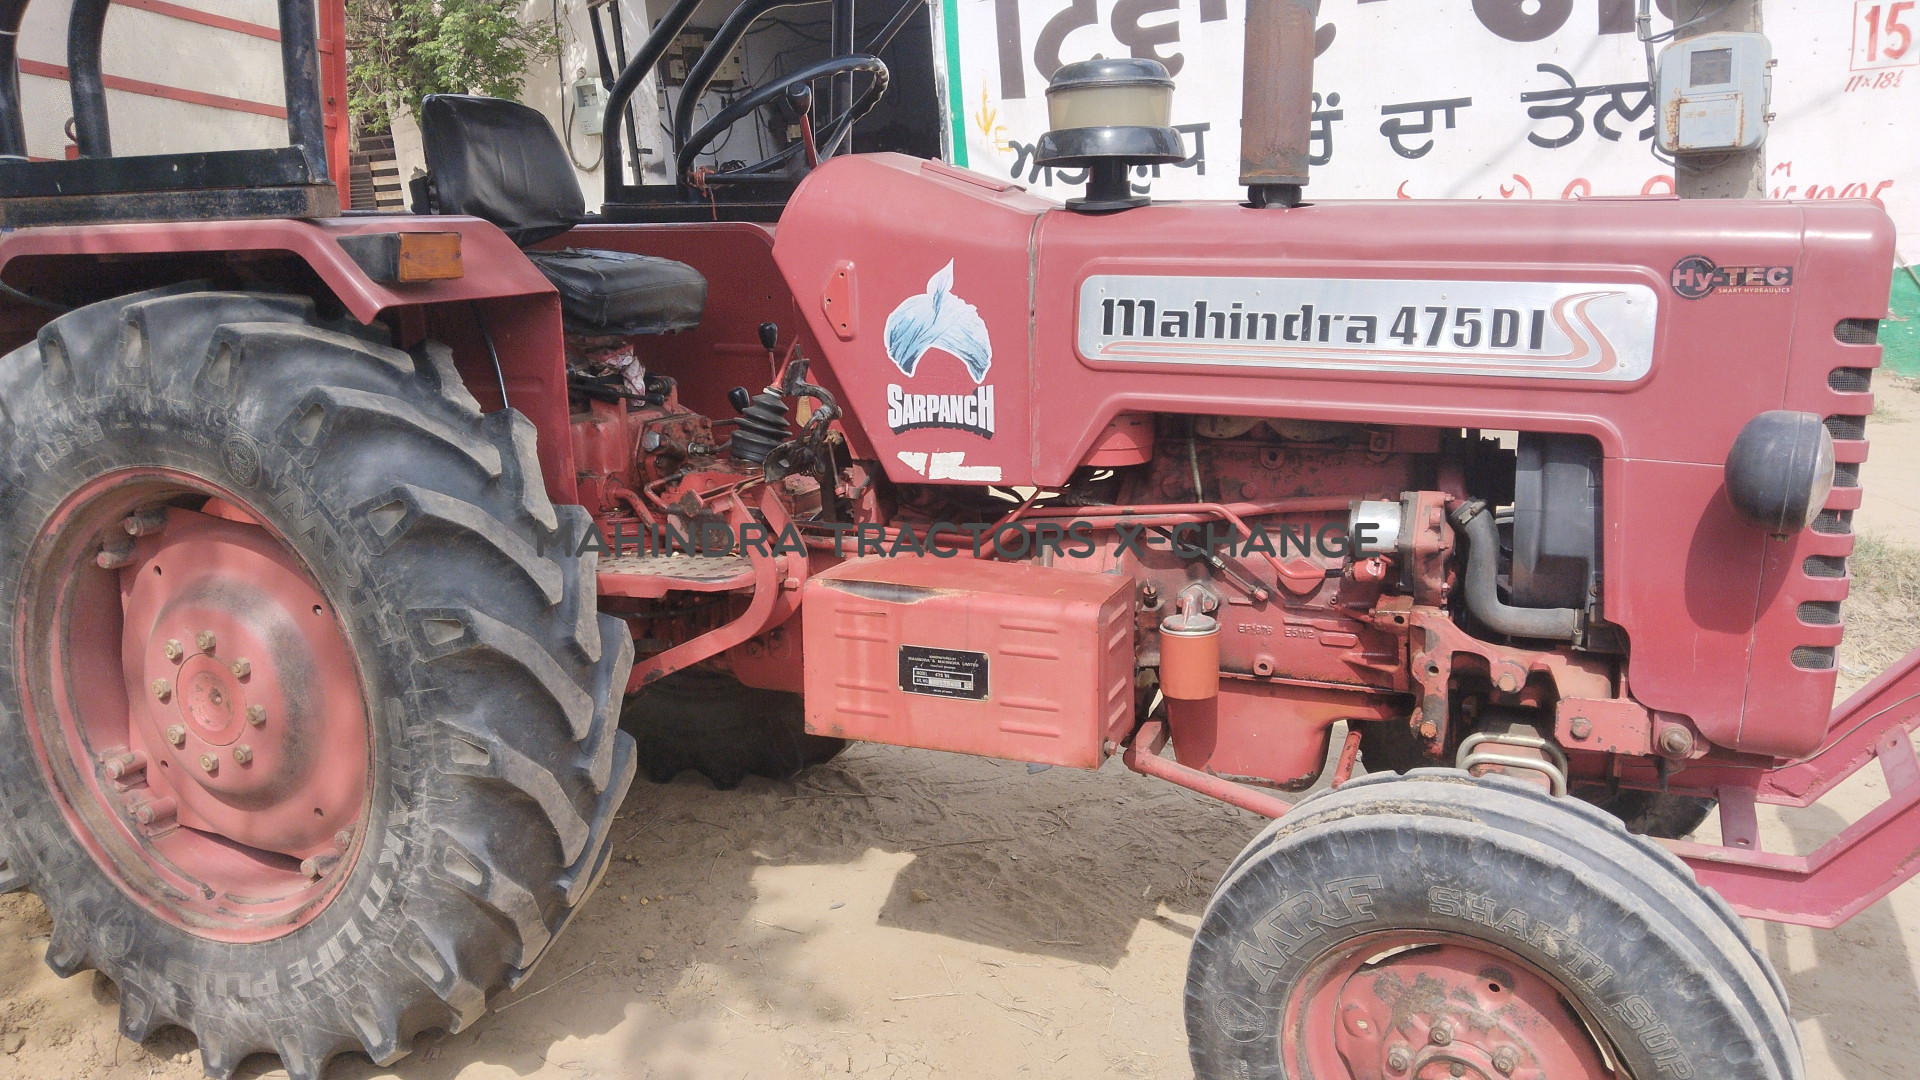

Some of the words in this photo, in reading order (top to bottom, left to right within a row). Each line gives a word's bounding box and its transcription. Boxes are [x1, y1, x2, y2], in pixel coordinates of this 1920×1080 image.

[1864, 1, 1915, 62] 15
[1379, 97, 1473, 158] ਦਾ
[1672, 267, 1789, 291] Hy-TEC
[1101, 297, 1378, 344] Mahindra
[887, 383, 995, 436] SARPANCH
[1231, 875, 1383, 995] MRF
[1428, 885, 1616, 990] SHAKTI
